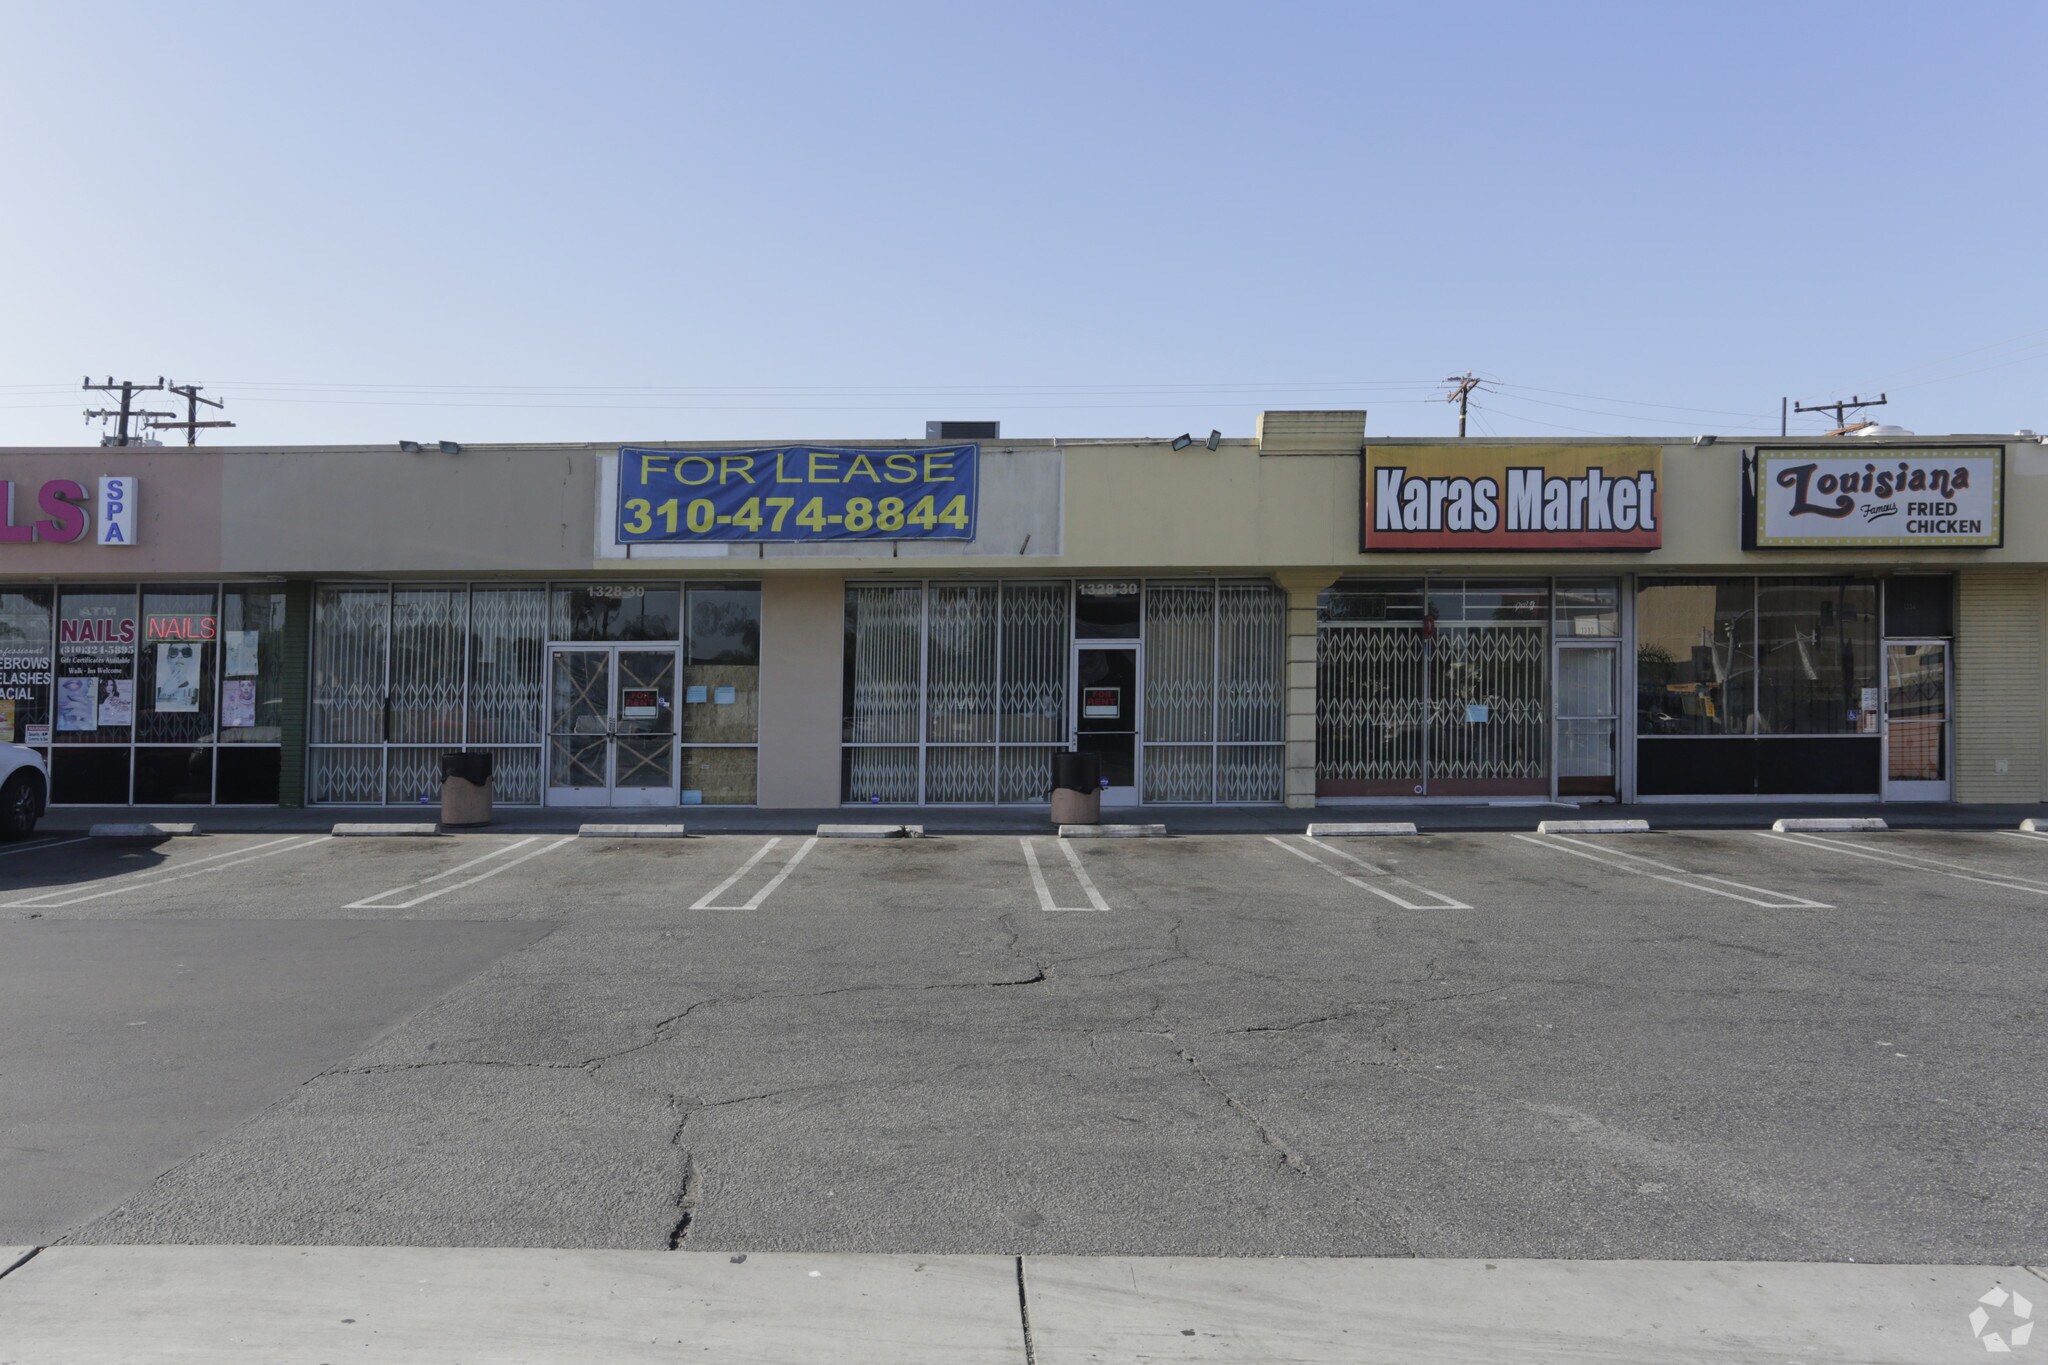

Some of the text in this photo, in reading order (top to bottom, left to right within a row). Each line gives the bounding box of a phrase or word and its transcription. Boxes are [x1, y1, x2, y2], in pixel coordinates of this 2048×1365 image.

[640, 452, 956, 486] FOR LEASE
[1776, 462, 1969, 518] Louisiana
[1373, 466, 1657, 533] Karas Market
[623, 494, 970, 535] 310-474-8844
[1860, 502, 1898, 523] Famous
[1907, 502, 1958, 517] FRIED
[1906, 519, 1982, 534] CHICKEN
[586, 586, 645, 598] 1328-30
[1078, 583, 1137, 596] 1328-30
[60, 618, 135, 643] NAILS
[149, 617, 216, 639] NAILS
[60, 656, 131, 664] Gift Certificates Available
[631, 691, 651, 699] FOR
[1092, 690, 1112, 698] FOR
[626, 698, 655, 706] RENT
